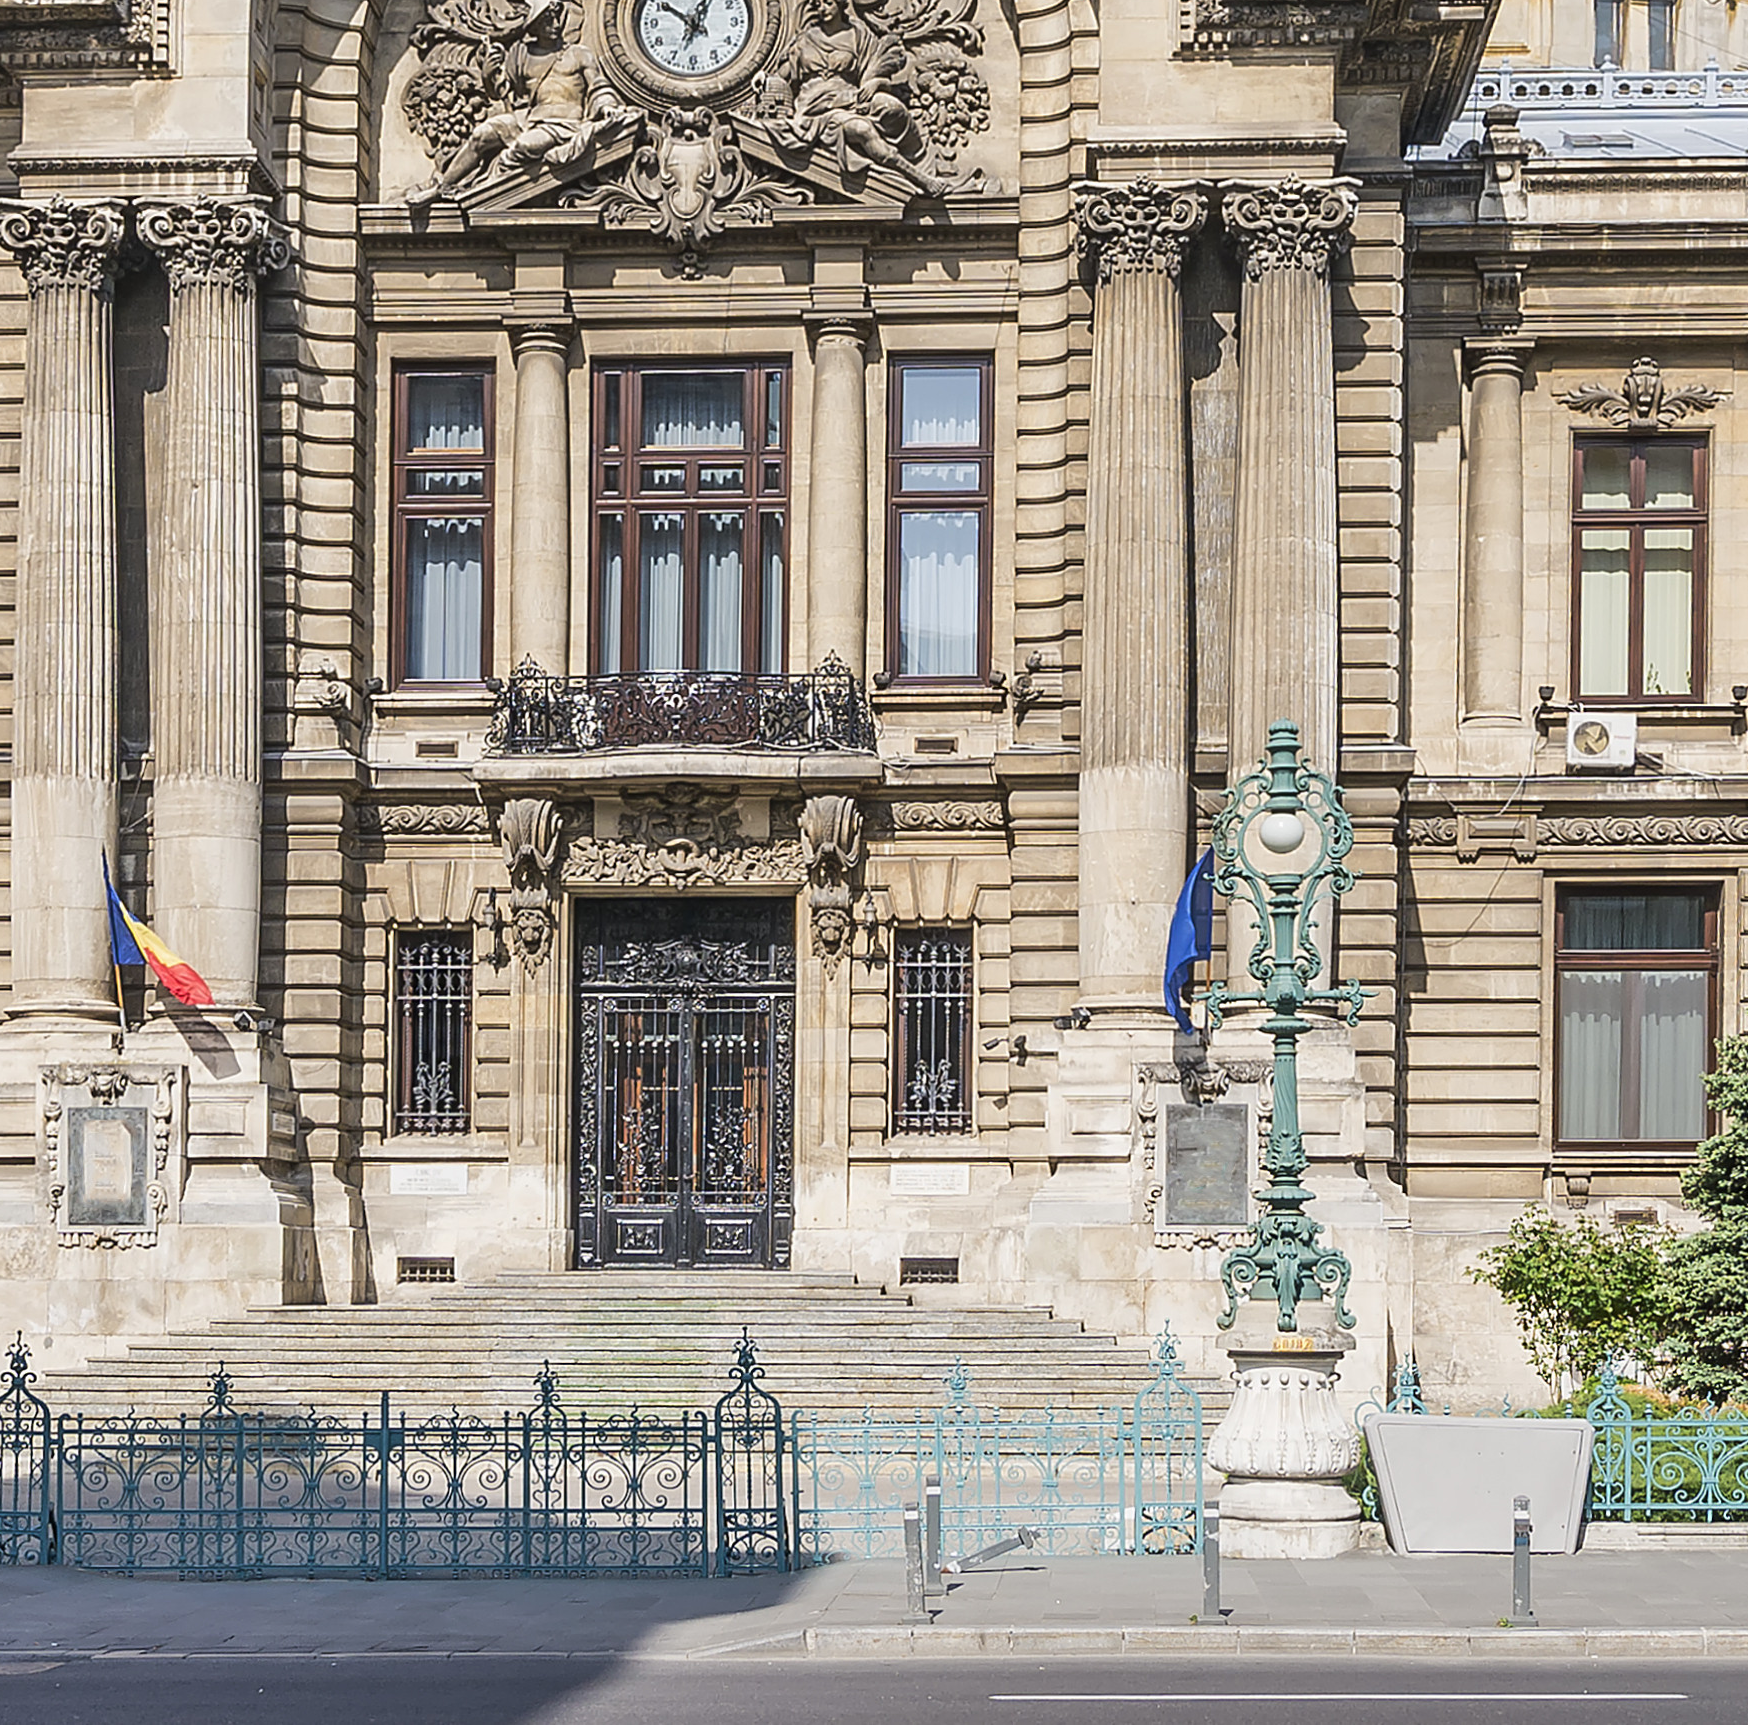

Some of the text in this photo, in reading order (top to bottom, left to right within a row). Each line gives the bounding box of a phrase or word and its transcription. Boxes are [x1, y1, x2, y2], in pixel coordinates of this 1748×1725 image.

[725, 0, 734, 10] 2
[650, 19, 658, 28] 9
[730, 17, 738, 27] 3
[655, 37, 663, 46] 8
[724, 35, 732, 45] 4
[670, 51, 677, 60] 7
[710, 50, 718, 59] 5
[690, 56, 697, 65] 6
